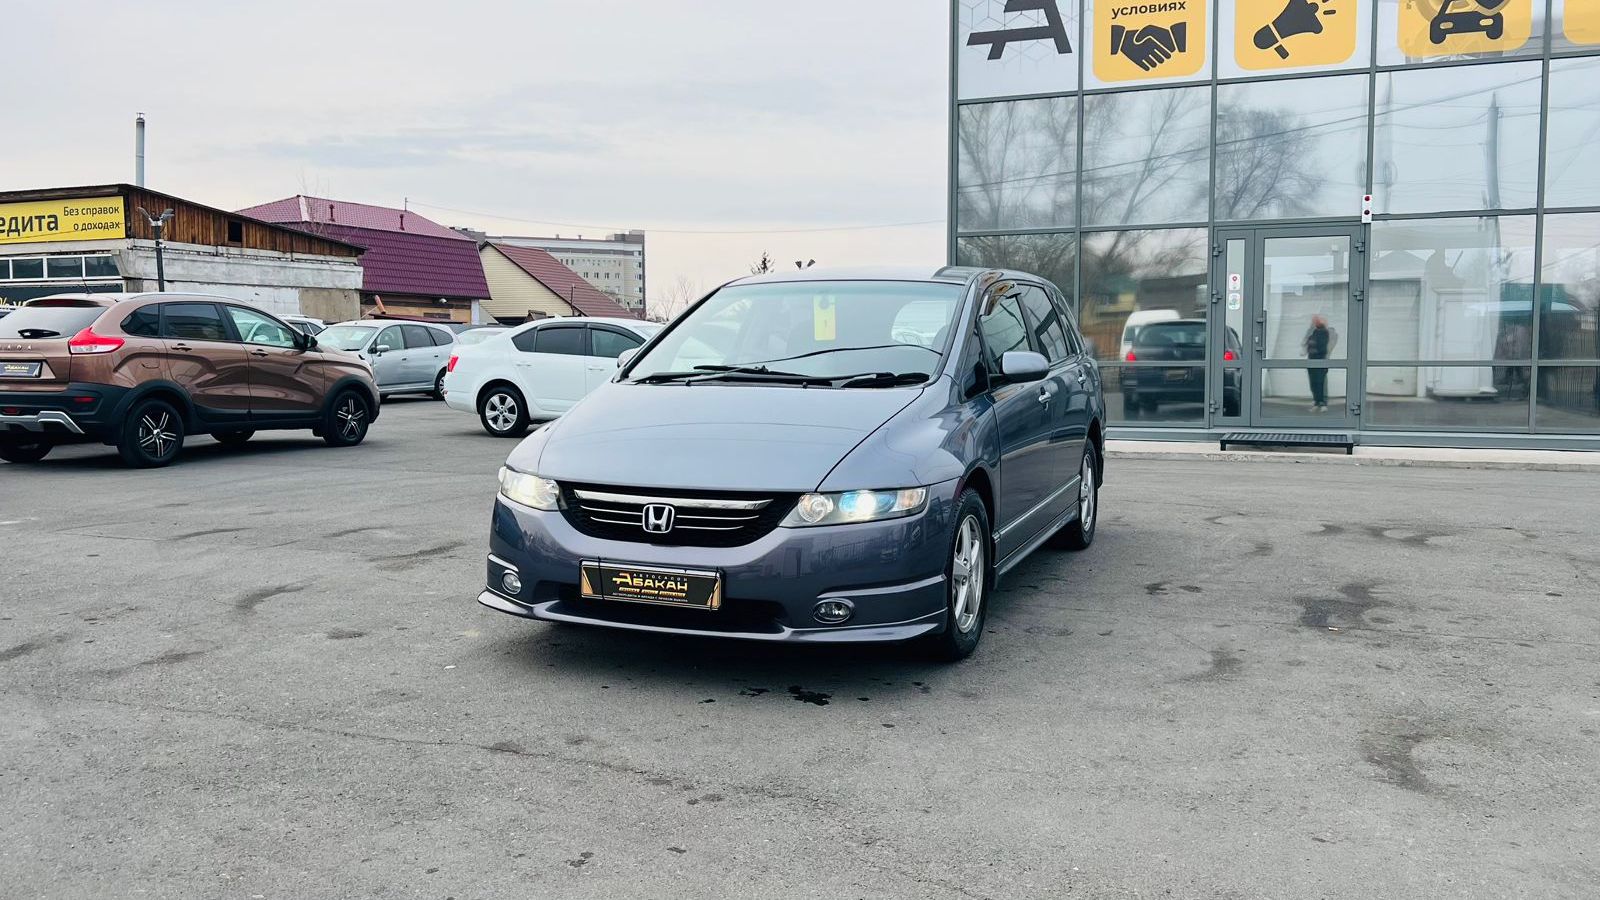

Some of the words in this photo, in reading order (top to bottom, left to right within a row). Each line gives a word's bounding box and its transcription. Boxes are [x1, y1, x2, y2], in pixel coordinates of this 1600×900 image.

[1111, 1, 1186, 20] условиях
[63, 206, 79, 217] Без
[81, 205, 120, 217] справок
[73, 223, 79, 231] о
[81, 221, 121, 232] доходах
